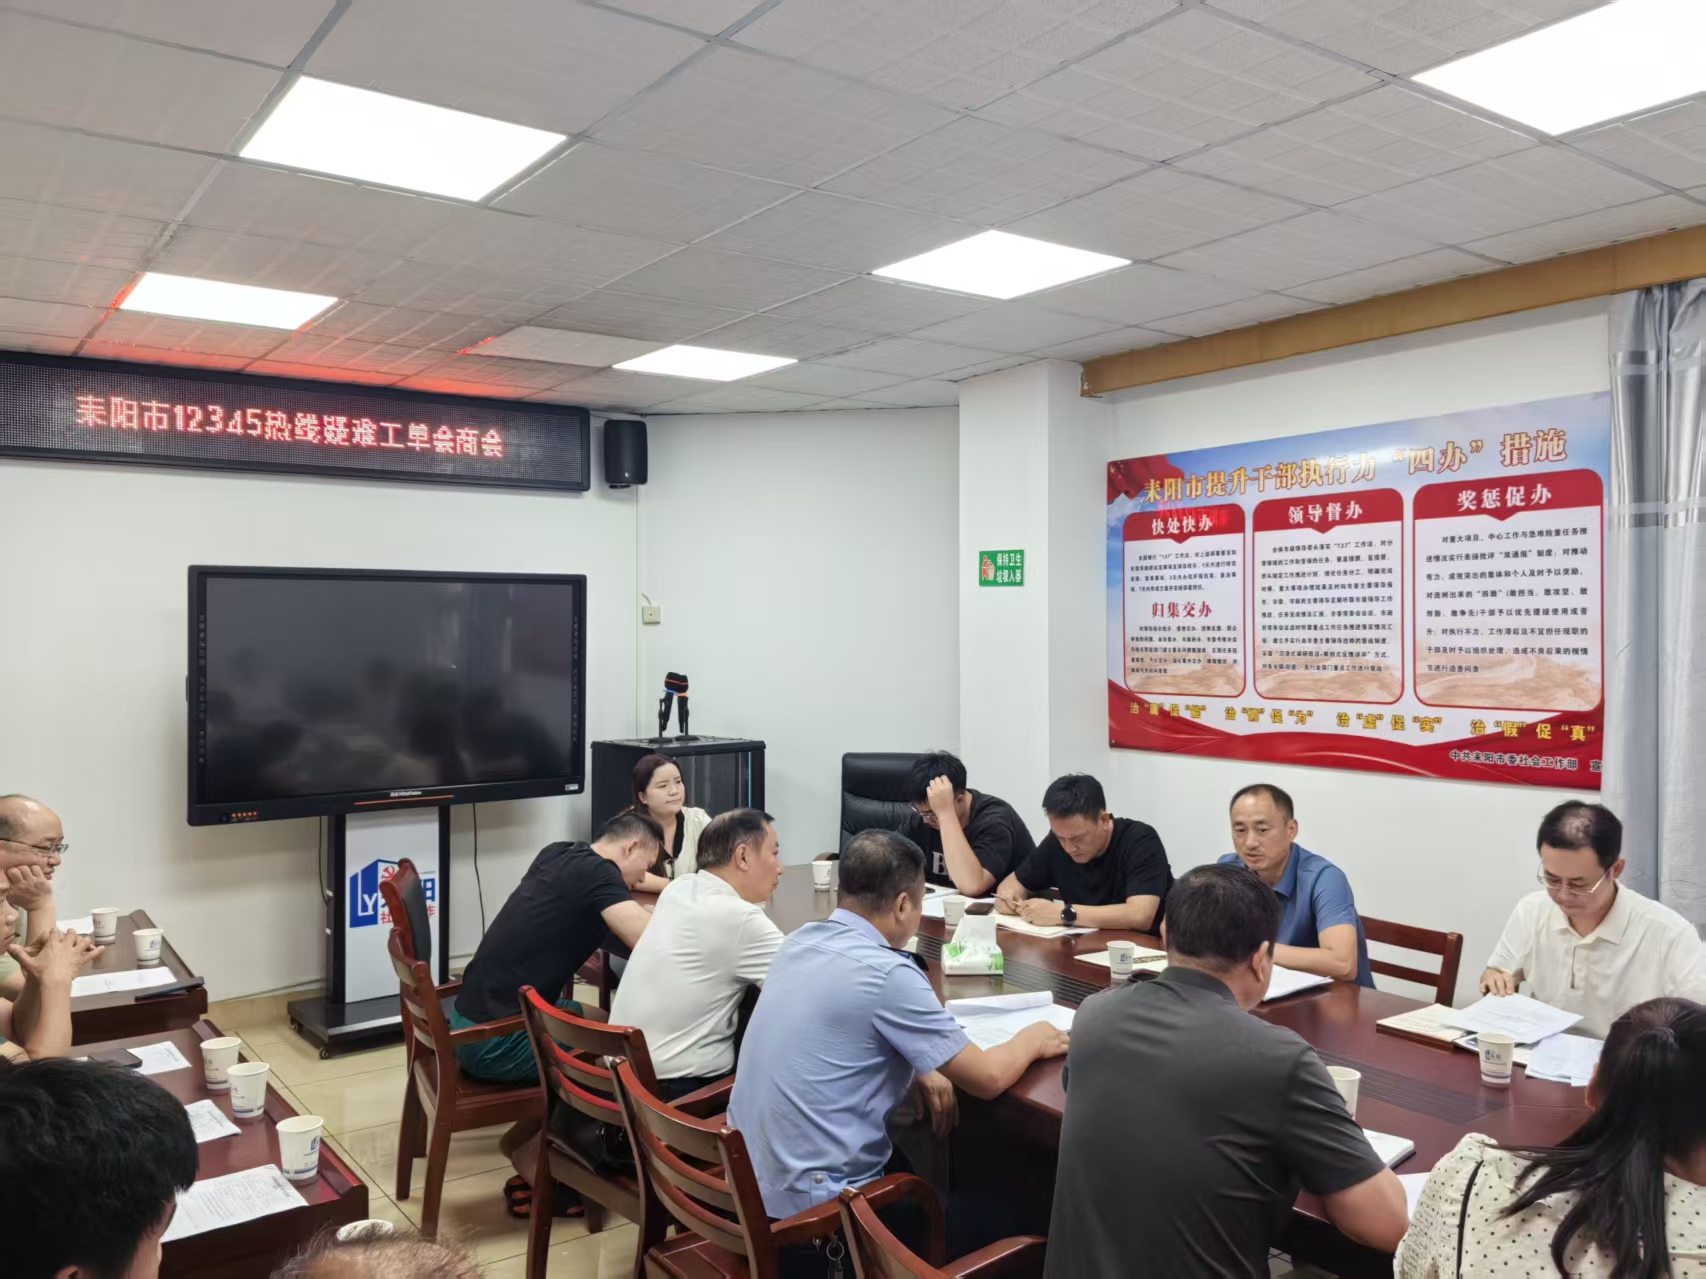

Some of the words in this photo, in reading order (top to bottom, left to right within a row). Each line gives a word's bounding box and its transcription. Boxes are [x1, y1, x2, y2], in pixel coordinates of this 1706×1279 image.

[75, 395, 503, 458] 耒阳市12345热线疑难工单会商会
[1457, 484, 1552, 512] 奖惩促办
[1288, 501, 1363, 524] 领导督办
[1152, 514, 1213, 534] 快处快办
[997, 552, 1022, 566] 保持卫生
[1152, 601, 1212, 618] 归集交办
[1449, 749, 1578, 770] 中共耒阳市委社会工作部
